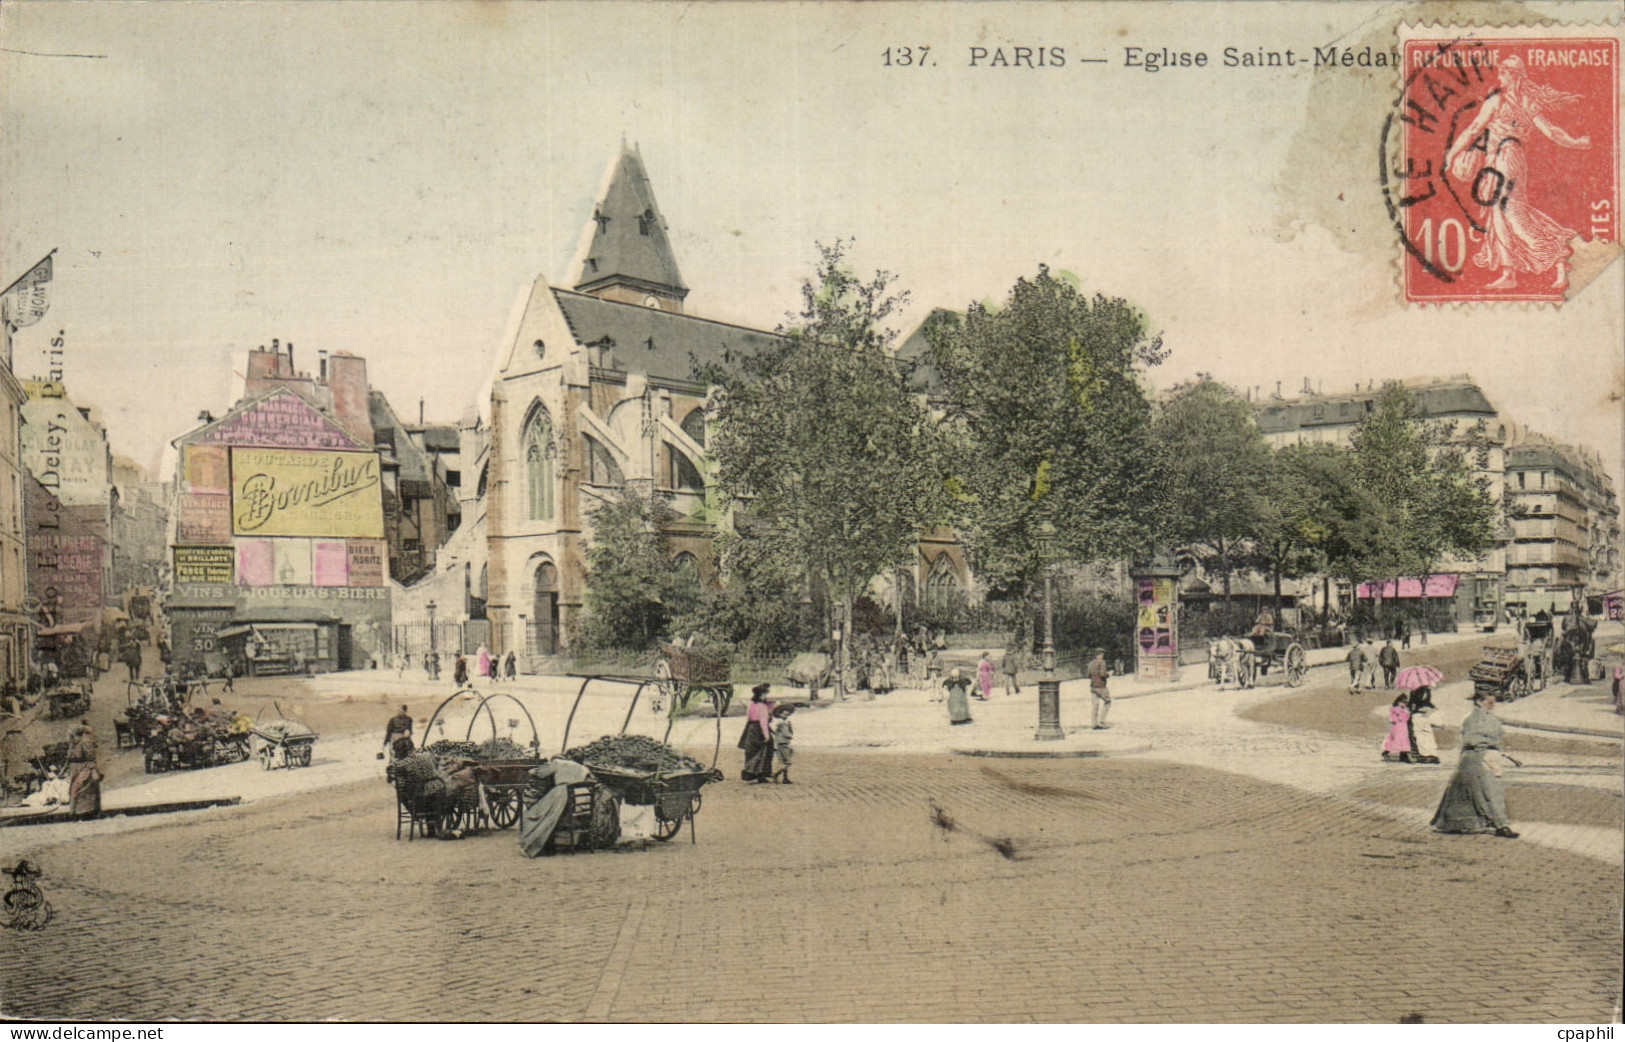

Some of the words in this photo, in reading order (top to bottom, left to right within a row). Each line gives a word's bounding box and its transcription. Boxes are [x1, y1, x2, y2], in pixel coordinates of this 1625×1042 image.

[1527, 49, 1610, 68] FRANÇAISE
[1590, 198, 1611, 245] TES
[176, 587, 224, 598] VINS
[237, 587, 329, 599] LIQUEURS
[337, 587, 386, 599] BIERE
[194, 638, 213, 651] 30
